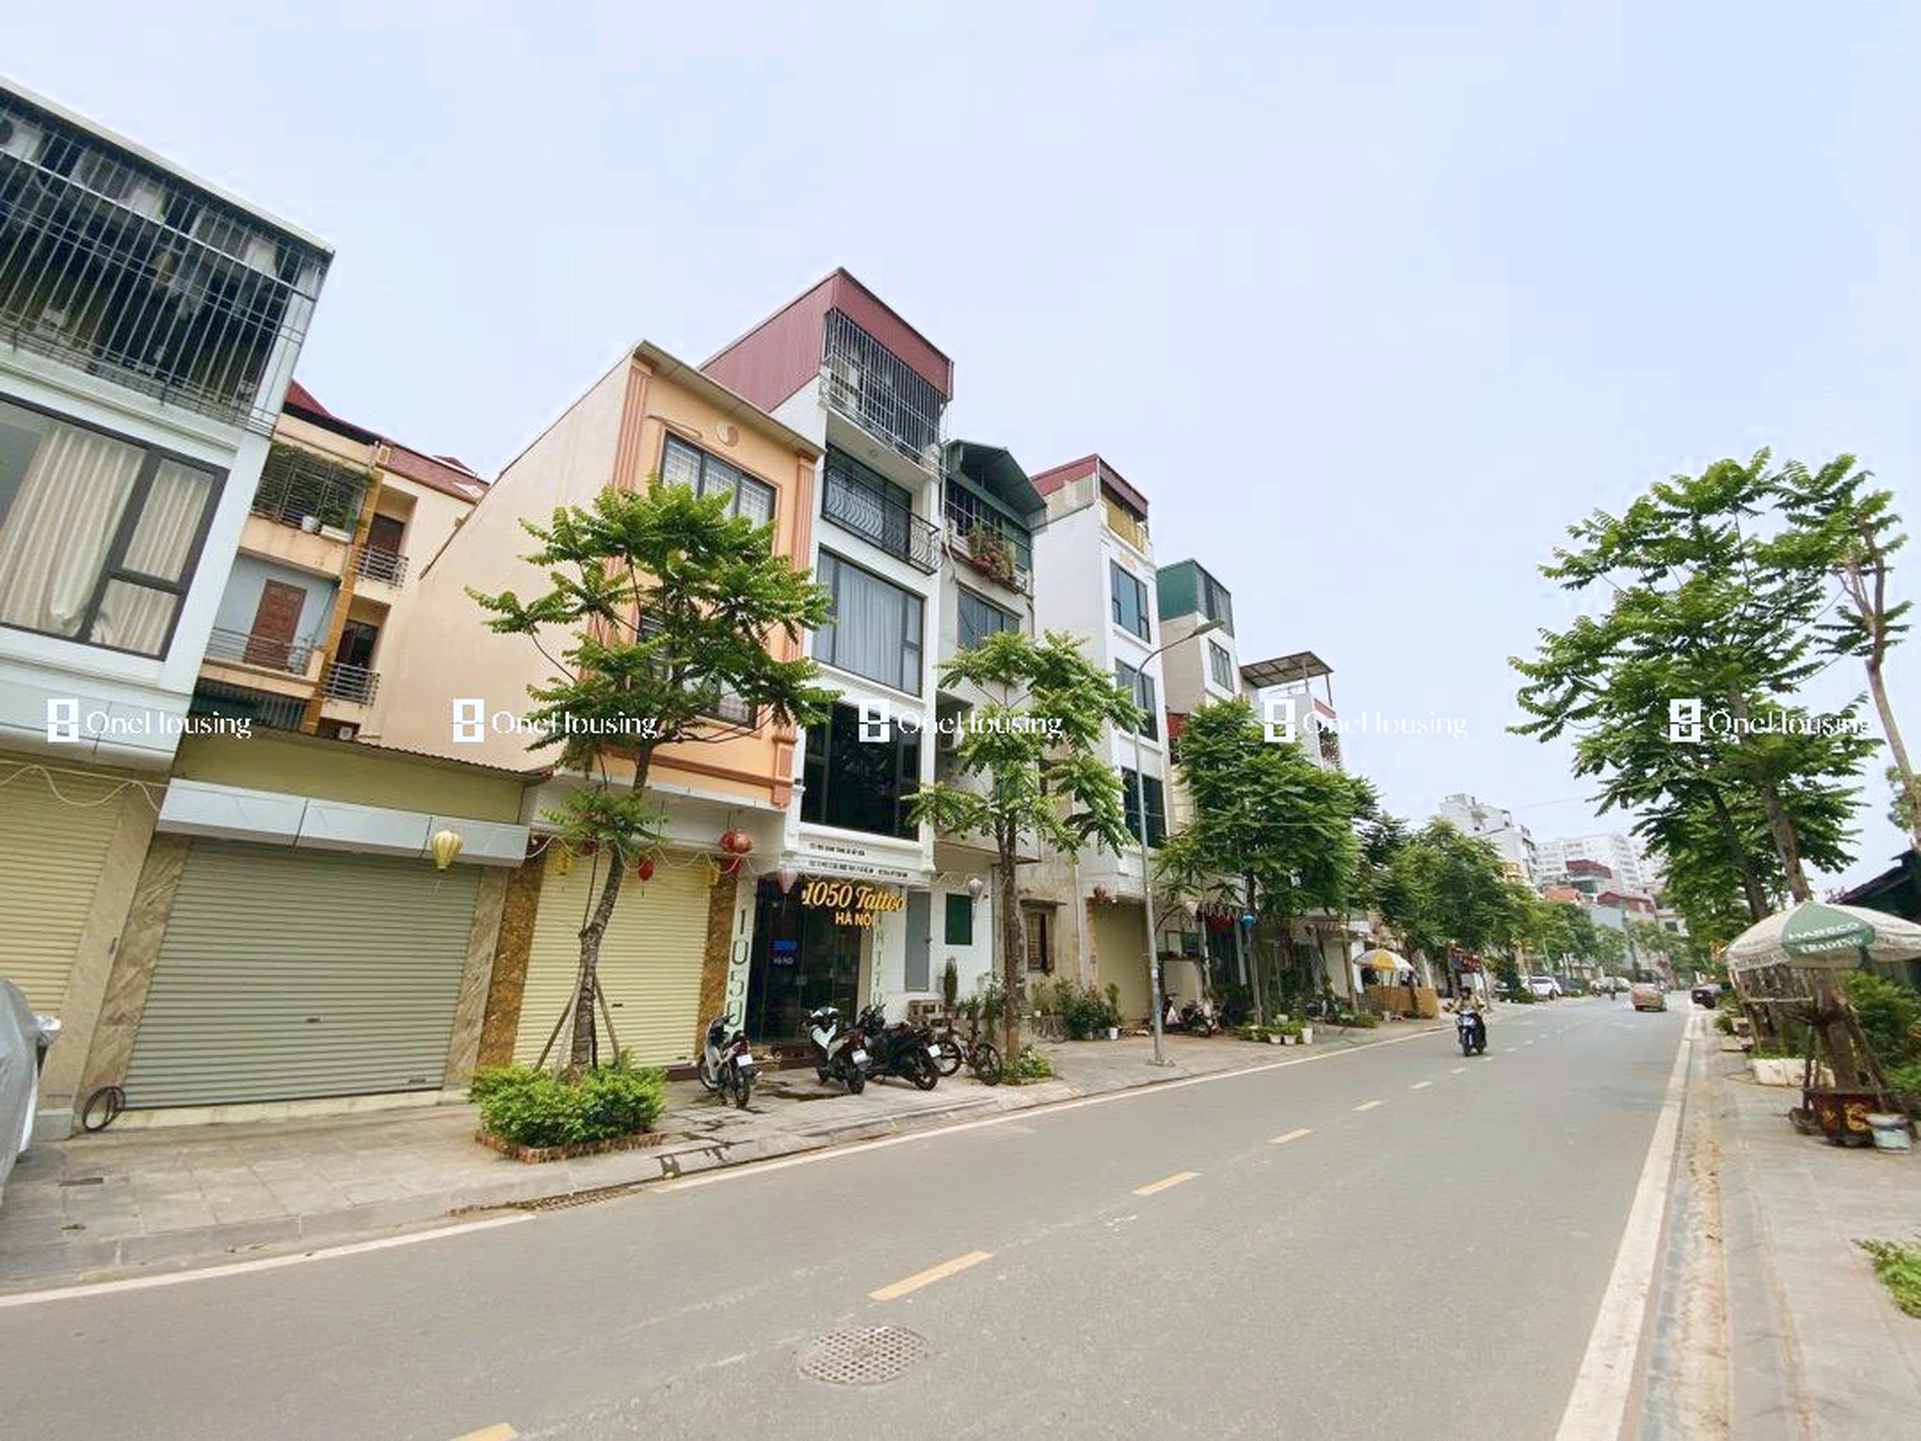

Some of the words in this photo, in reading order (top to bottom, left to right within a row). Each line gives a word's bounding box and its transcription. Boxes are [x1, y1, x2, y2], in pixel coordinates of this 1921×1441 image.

[801, 881, 853, 908] 1050
[856, 886, 906, 912] Tattoo
[835, 909, 853, 926] HÀ
[854, 910, 877, 930] NỘI
[1800, 937, 1863, 954] TRADING
[727, 908, 750, 1027] 1050
